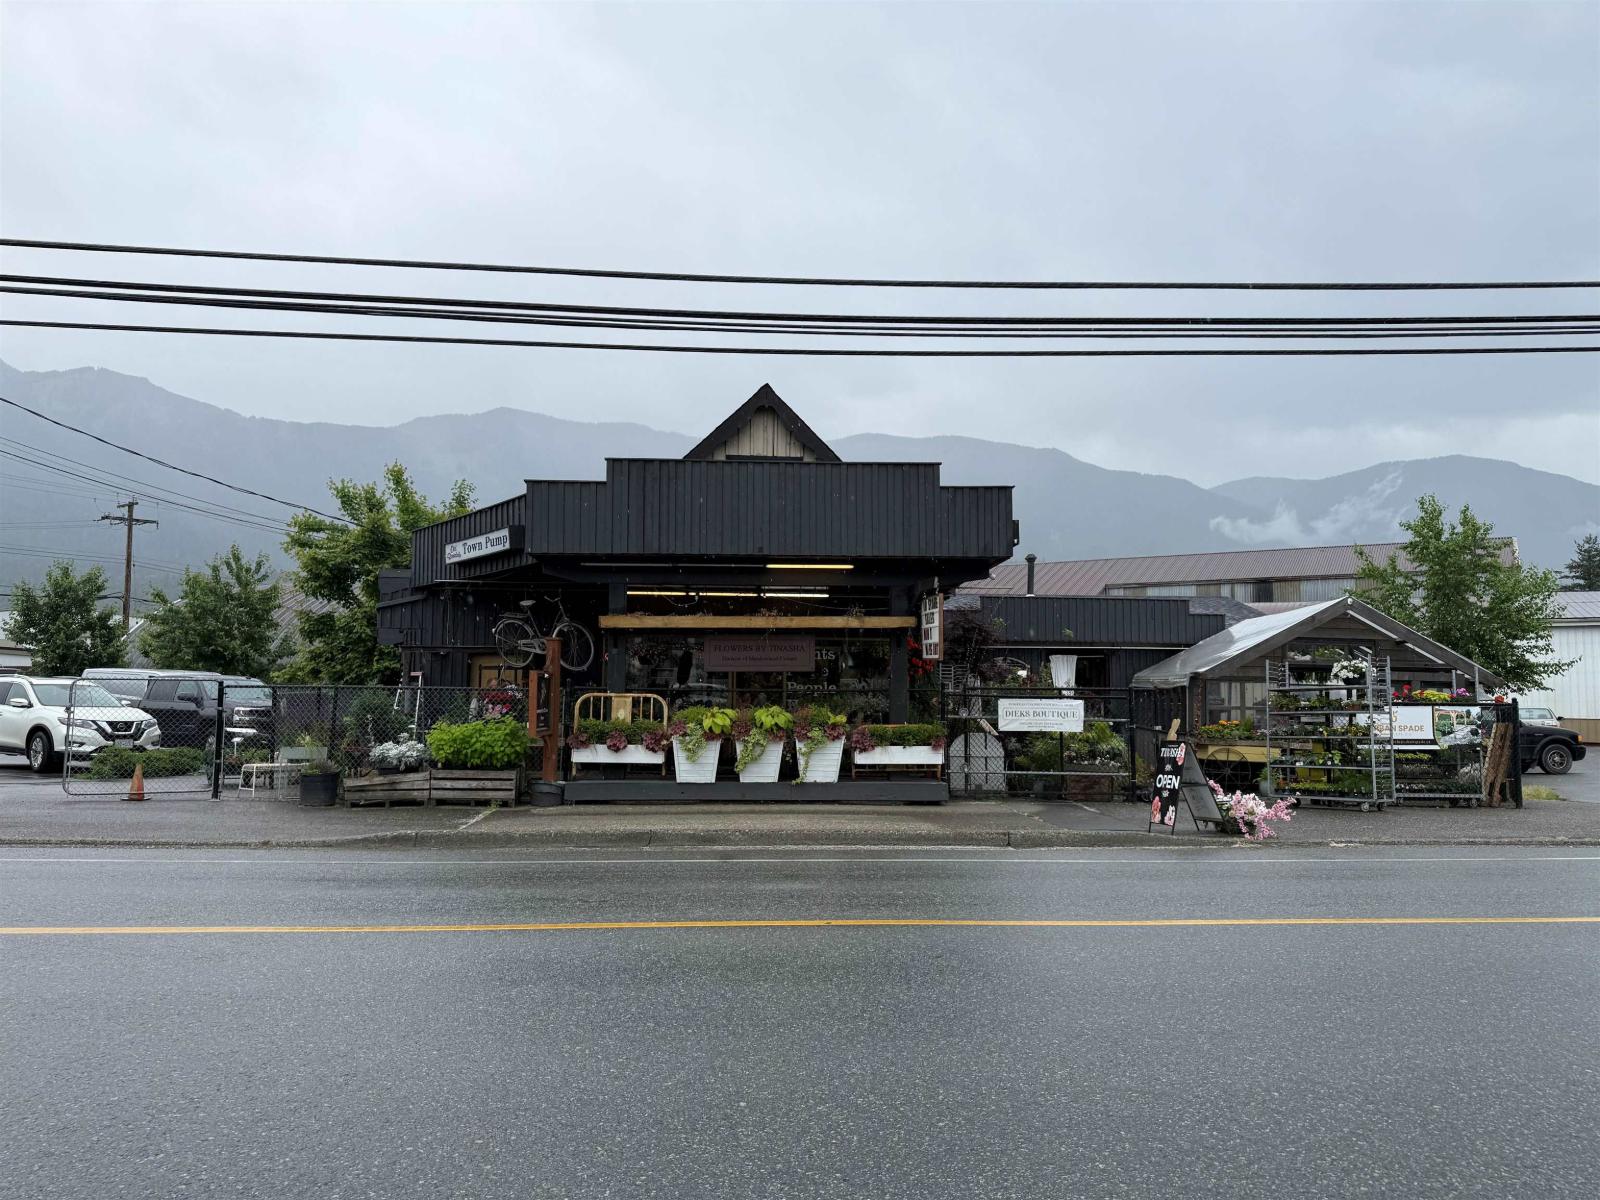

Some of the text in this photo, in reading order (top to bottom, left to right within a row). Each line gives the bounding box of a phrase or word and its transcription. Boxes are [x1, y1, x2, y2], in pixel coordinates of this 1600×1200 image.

[463, 541, 483, 555] Town
[485, 534, 508, 549] Pump
[712, 644, 806, 652] FLOWERS BY TINASHA
[786, 681, 837, 697] People
[1005, 710, 1078, 719] DIEKS BOUTIQUE
[1398, 724, 1425, 732] SPADE
[1156, 774, 1181, 790] OPEN
